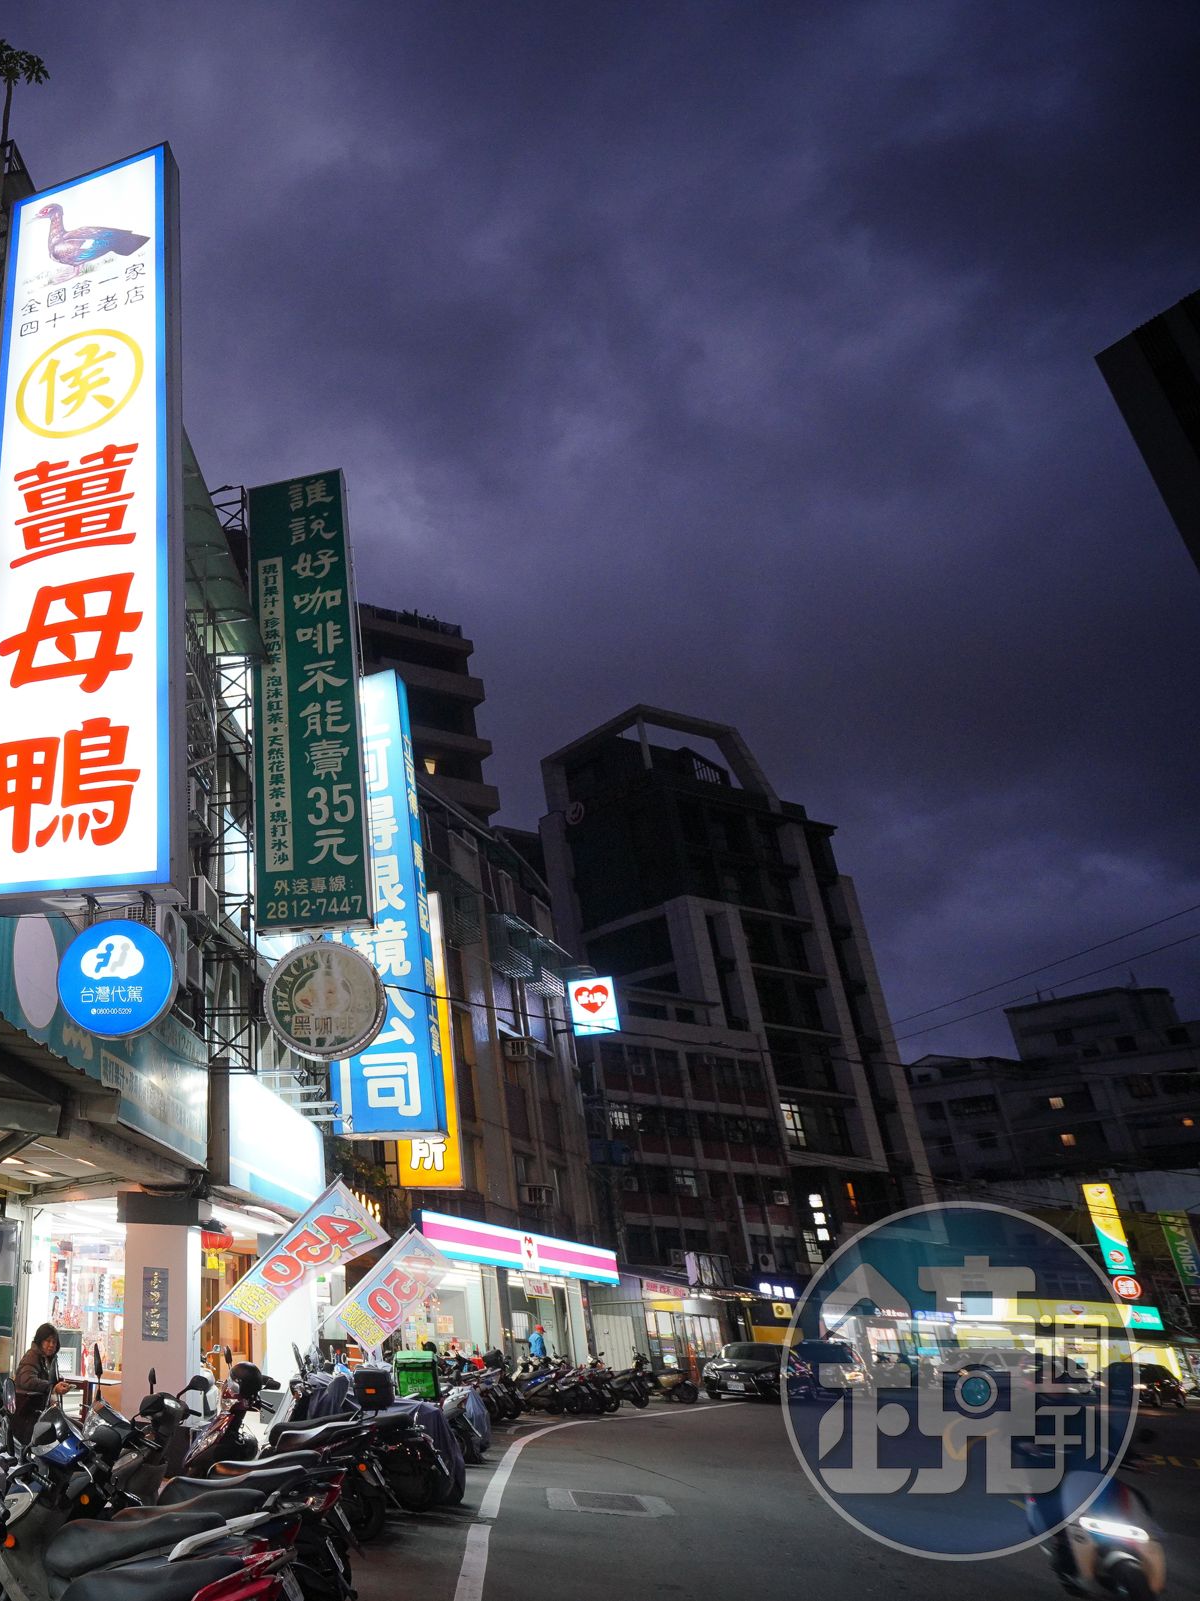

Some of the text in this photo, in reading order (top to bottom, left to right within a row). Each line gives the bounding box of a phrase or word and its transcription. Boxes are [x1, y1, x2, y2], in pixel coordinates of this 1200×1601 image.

[20, 263, 146, 317] 全國第一家
[19, 286, 145, 338] 四十年老店
[274, 875, 354, 897] 外送專線:
[266, 895, 362, 920] 2812-7447
[80, 985, 143, 1004] 台灣代駕
[277, 952, 317, 1012] BLACK
[409, 1139, 447, 1171] 所
